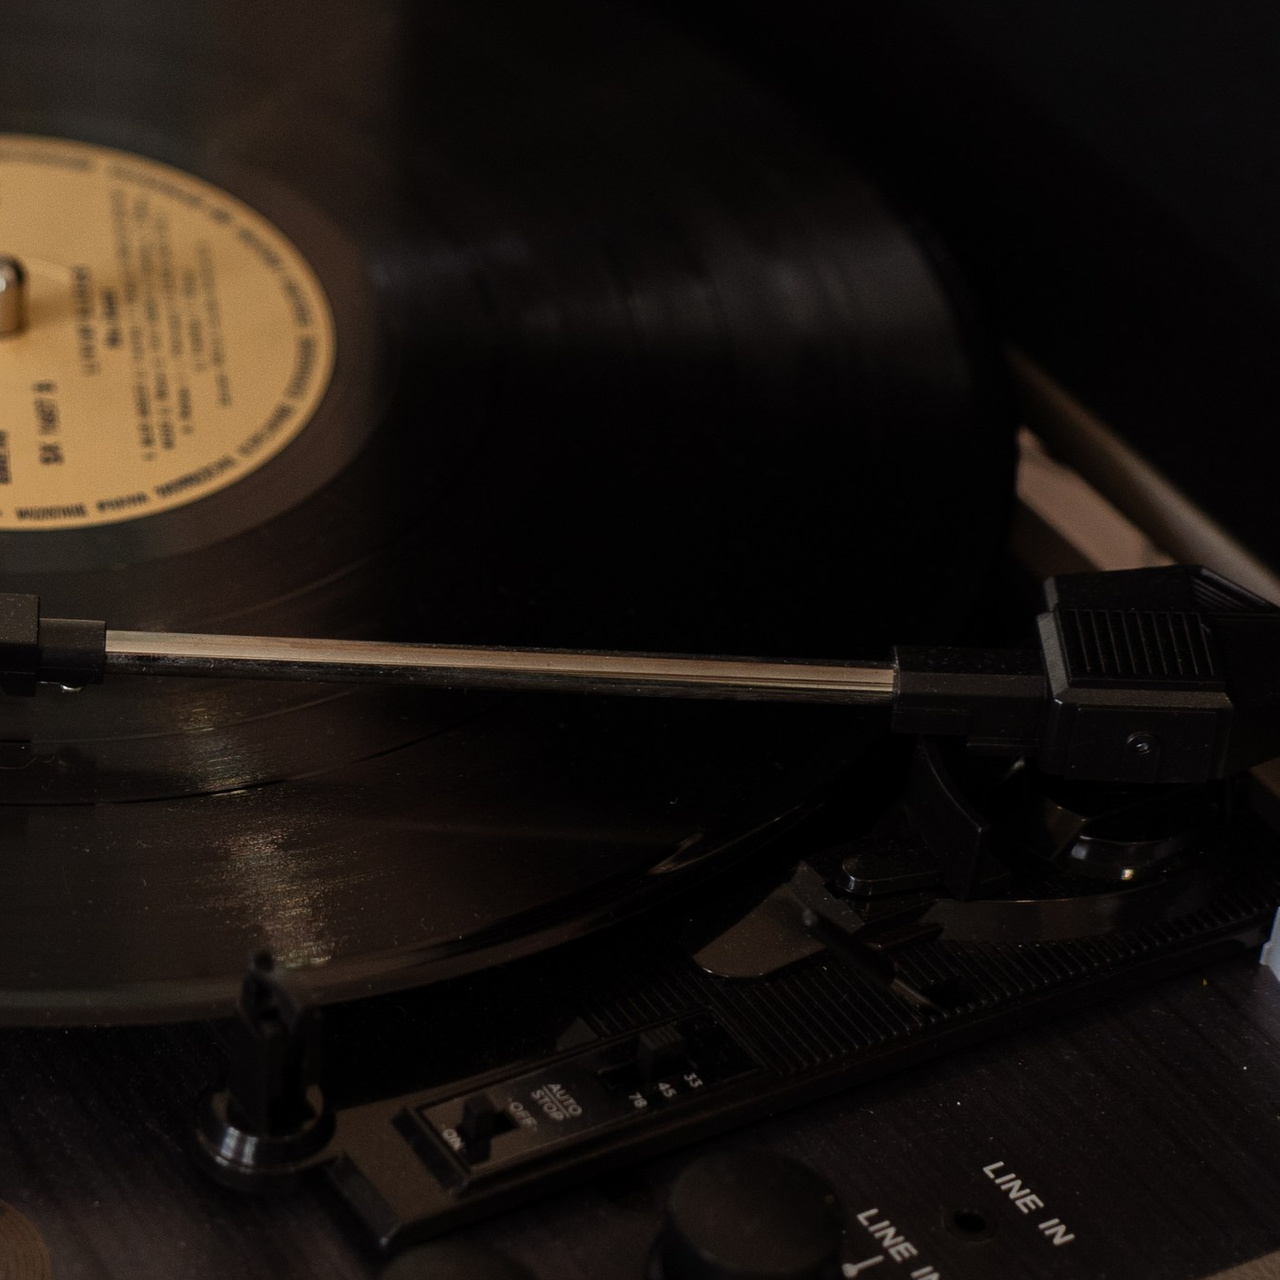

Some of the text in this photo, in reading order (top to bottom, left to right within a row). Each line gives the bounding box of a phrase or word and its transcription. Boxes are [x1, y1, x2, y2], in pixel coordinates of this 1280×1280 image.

[657, 1082, 677, 1099] 45
[683, 1072, 704, 1089] 33
[531, 1089, 565, 1121] STOP
[547, 1083, 583, 1117] AUTO
[628, 1092, 648, 1110] 78
[509, 1101, 538, 1131] OFF
[441, 1127, 464, 1152] ON
[982, 1160, 1076, 1247] LINE IN
[856, 1207, 918, 1264] LINE
